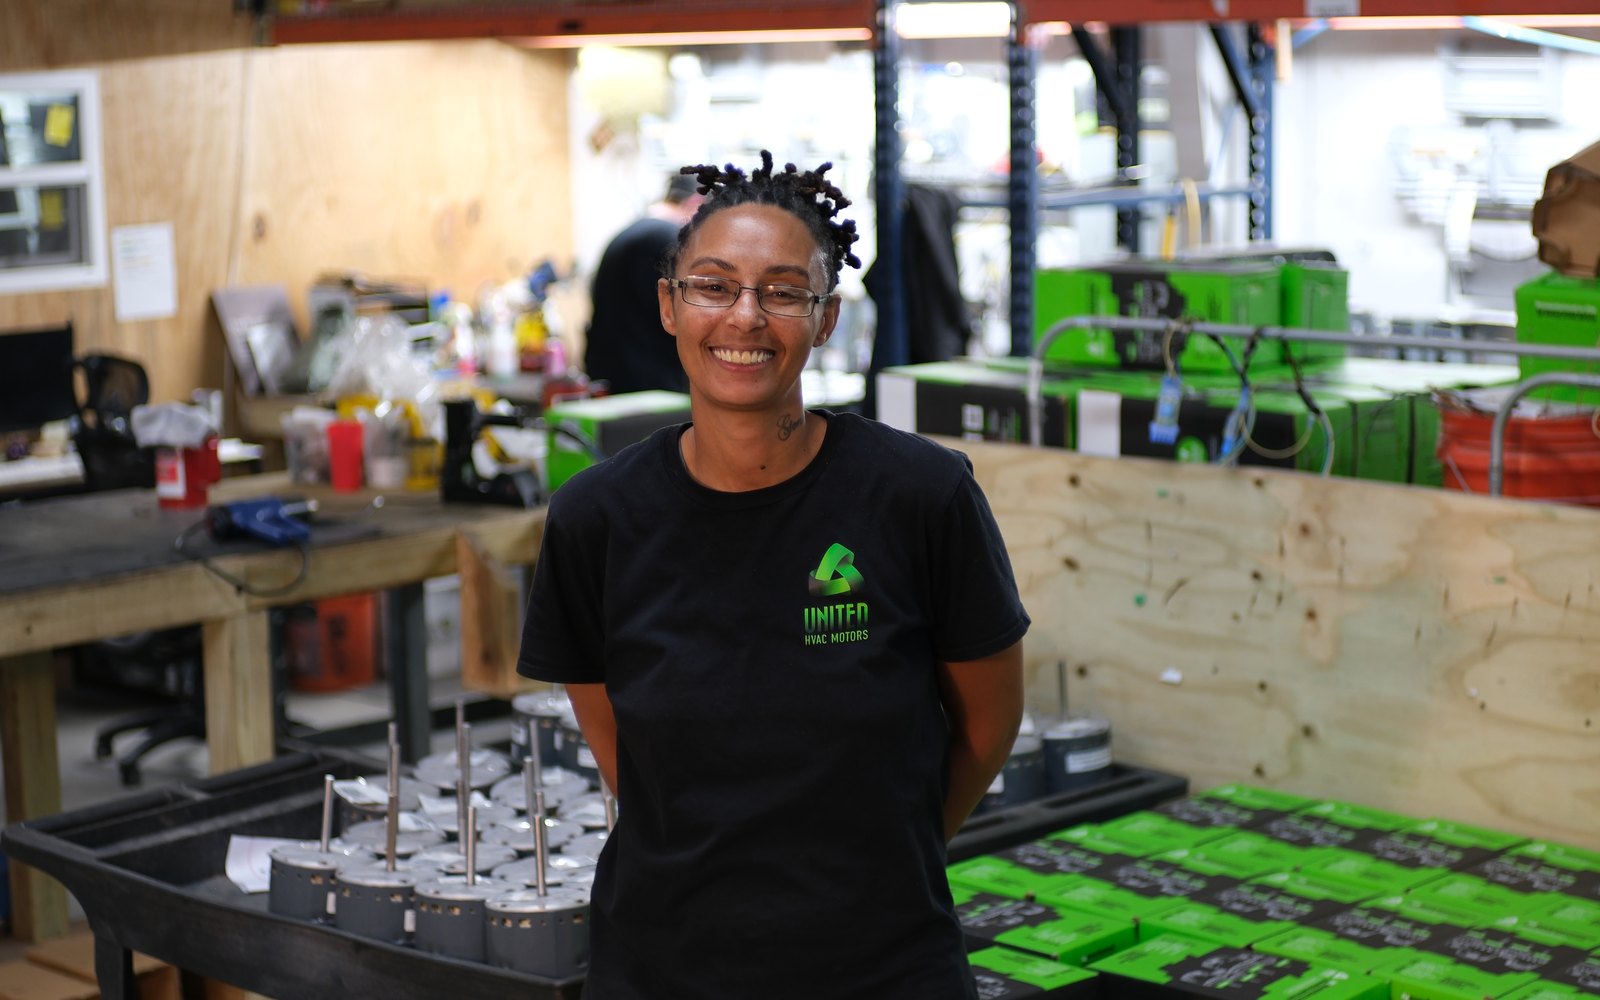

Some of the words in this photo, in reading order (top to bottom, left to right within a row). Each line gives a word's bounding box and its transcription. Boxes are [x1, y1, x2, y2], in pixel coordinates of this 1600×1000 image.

[804, 602, 868, 633] UNITED
[804, 634, 828, 646] HVAC
[831, 629, 869, 644] MOTORS
